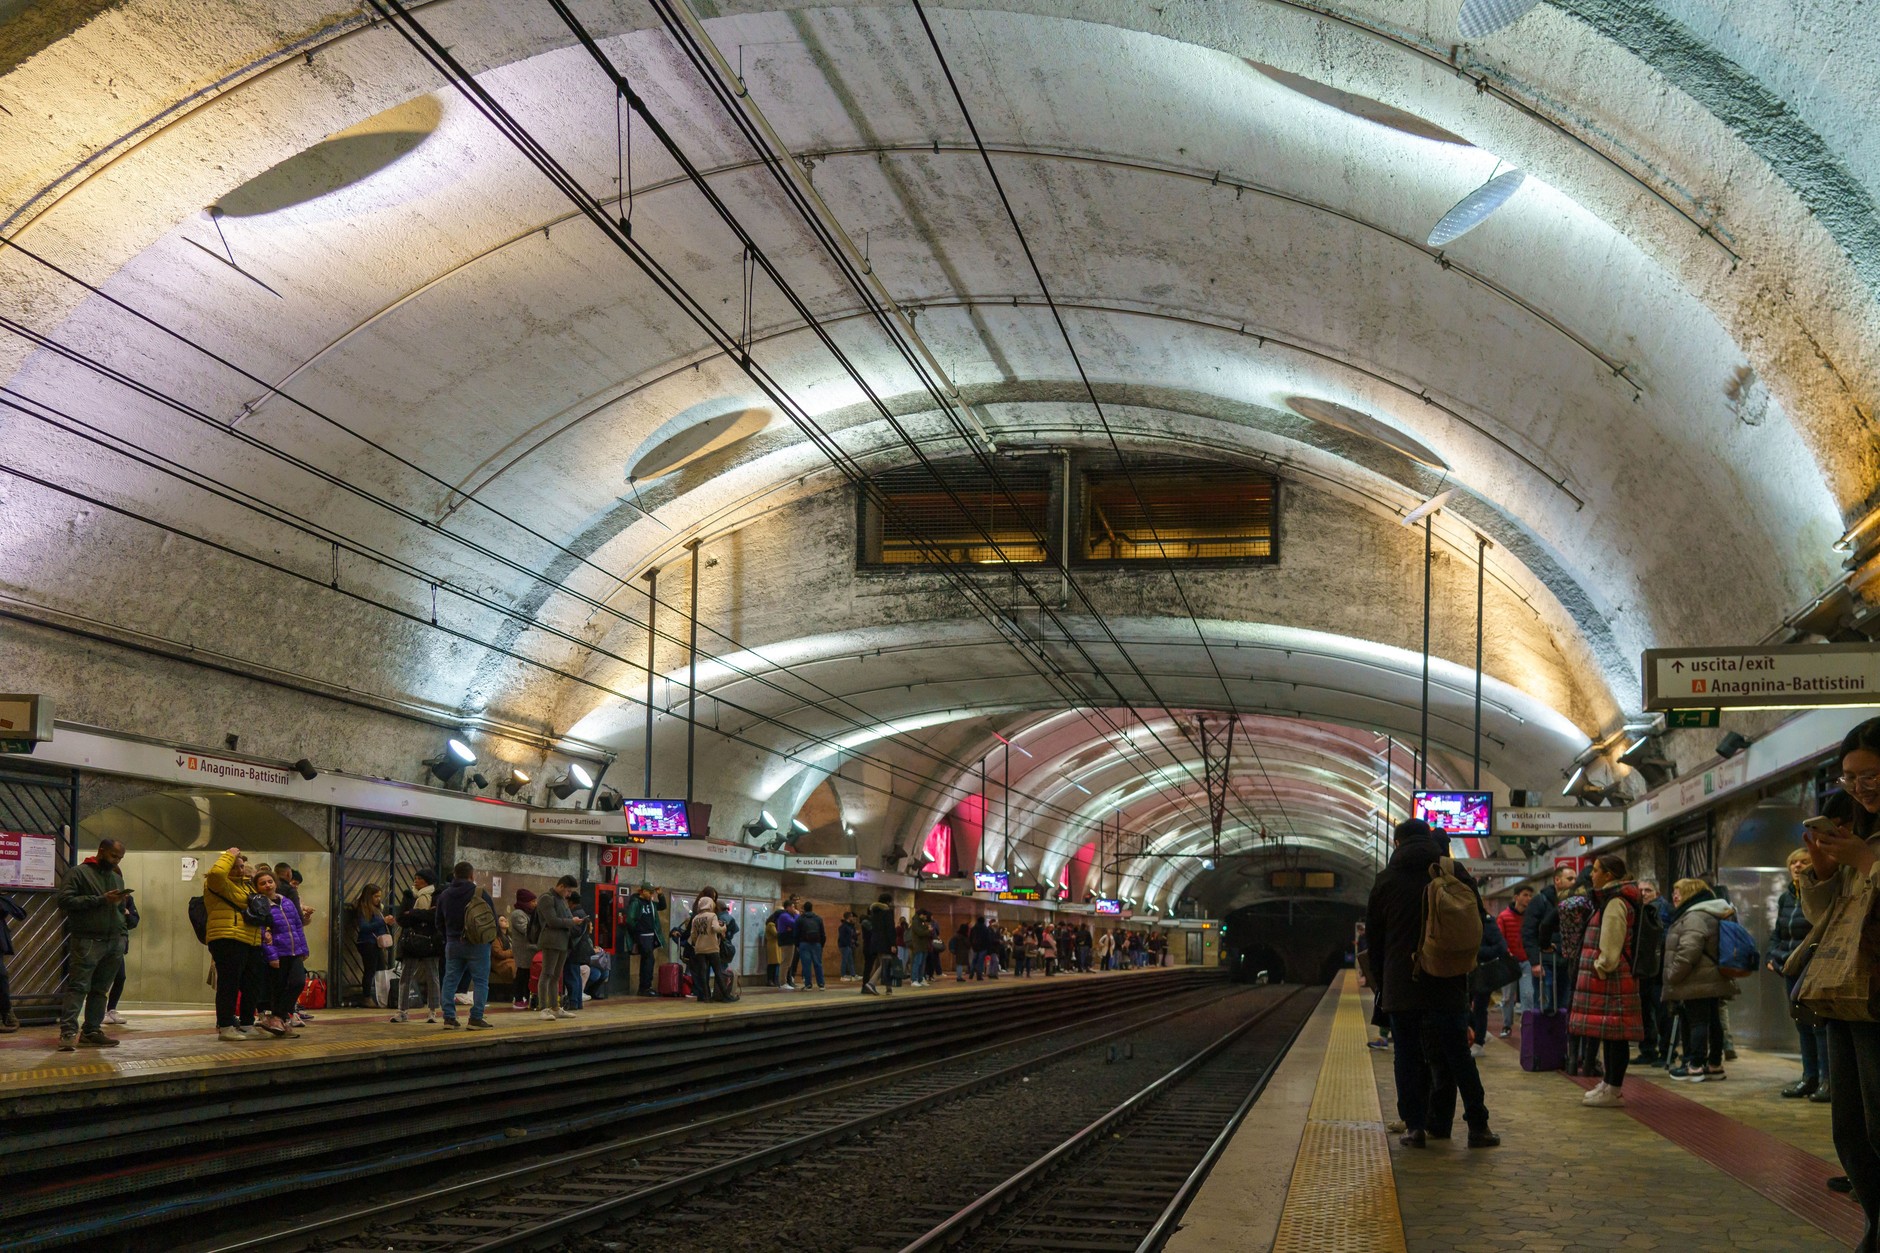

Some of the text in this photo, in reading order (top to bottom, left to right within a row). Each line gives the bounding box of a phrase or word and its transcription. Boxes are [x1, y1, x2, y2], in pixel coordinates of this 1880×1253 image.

[1691, 656, 1776, 672] uscita/exit
[1711, 675, 1865, 696] Anagnina-Battistini
[200, 759, 289, 785] Anagnina-Battistini
[1511, 811, 1551, 820] uscita/exit
[546, 817, 601, 826] Anagnina-Battistini
[1521, 821, 1592, 831] Anagnina-Battistini
[803, 858, 838, 866] uscita/exit
